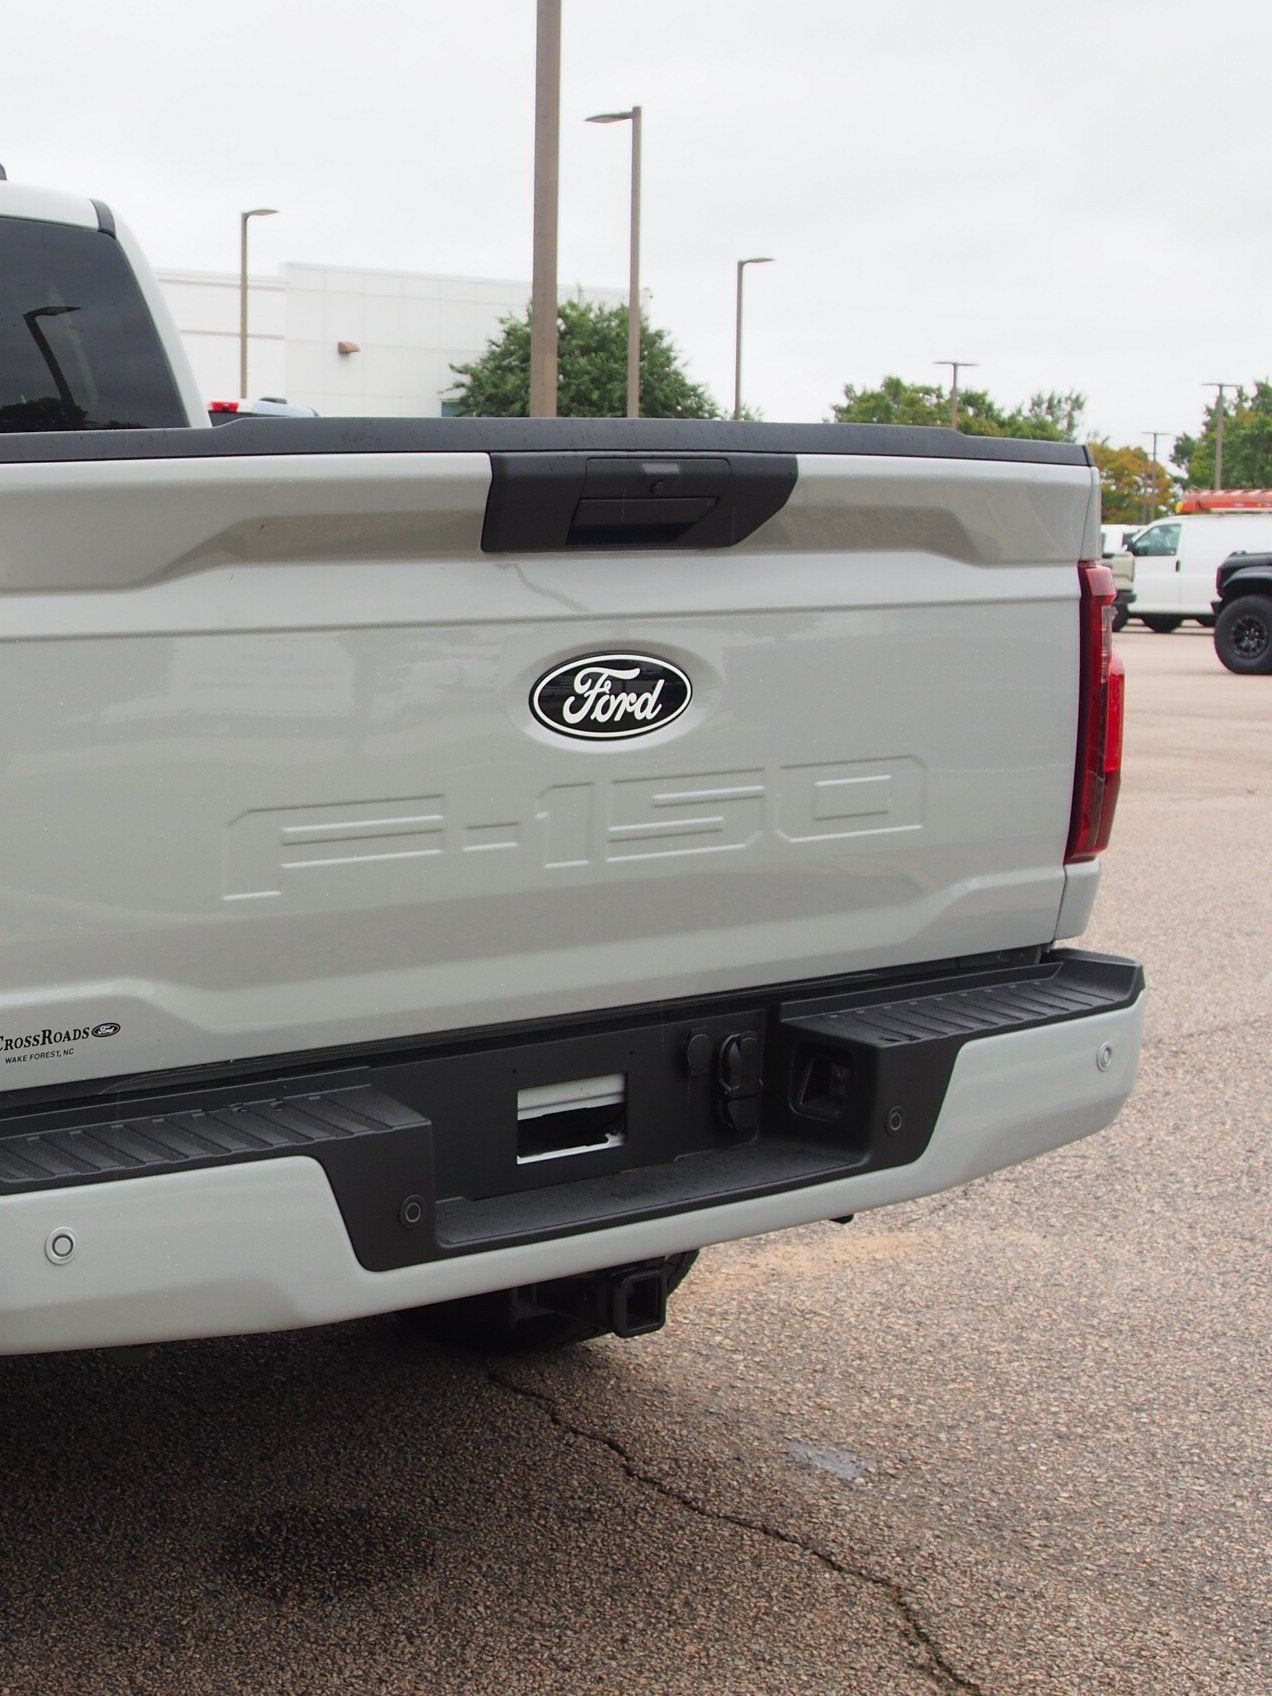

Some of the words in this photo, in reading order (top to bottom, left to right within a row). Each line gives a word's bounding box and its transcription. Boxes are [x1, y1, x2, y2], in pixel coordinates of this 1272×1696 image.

[562, 666, 665, 724] Ford
[222, 754, 926, 901] F-150
[5, 1054, 28, 1064] WAKE
[29, 1050, 62, 1061] FOREST,
[63, 1048, 74, 1056] NC
